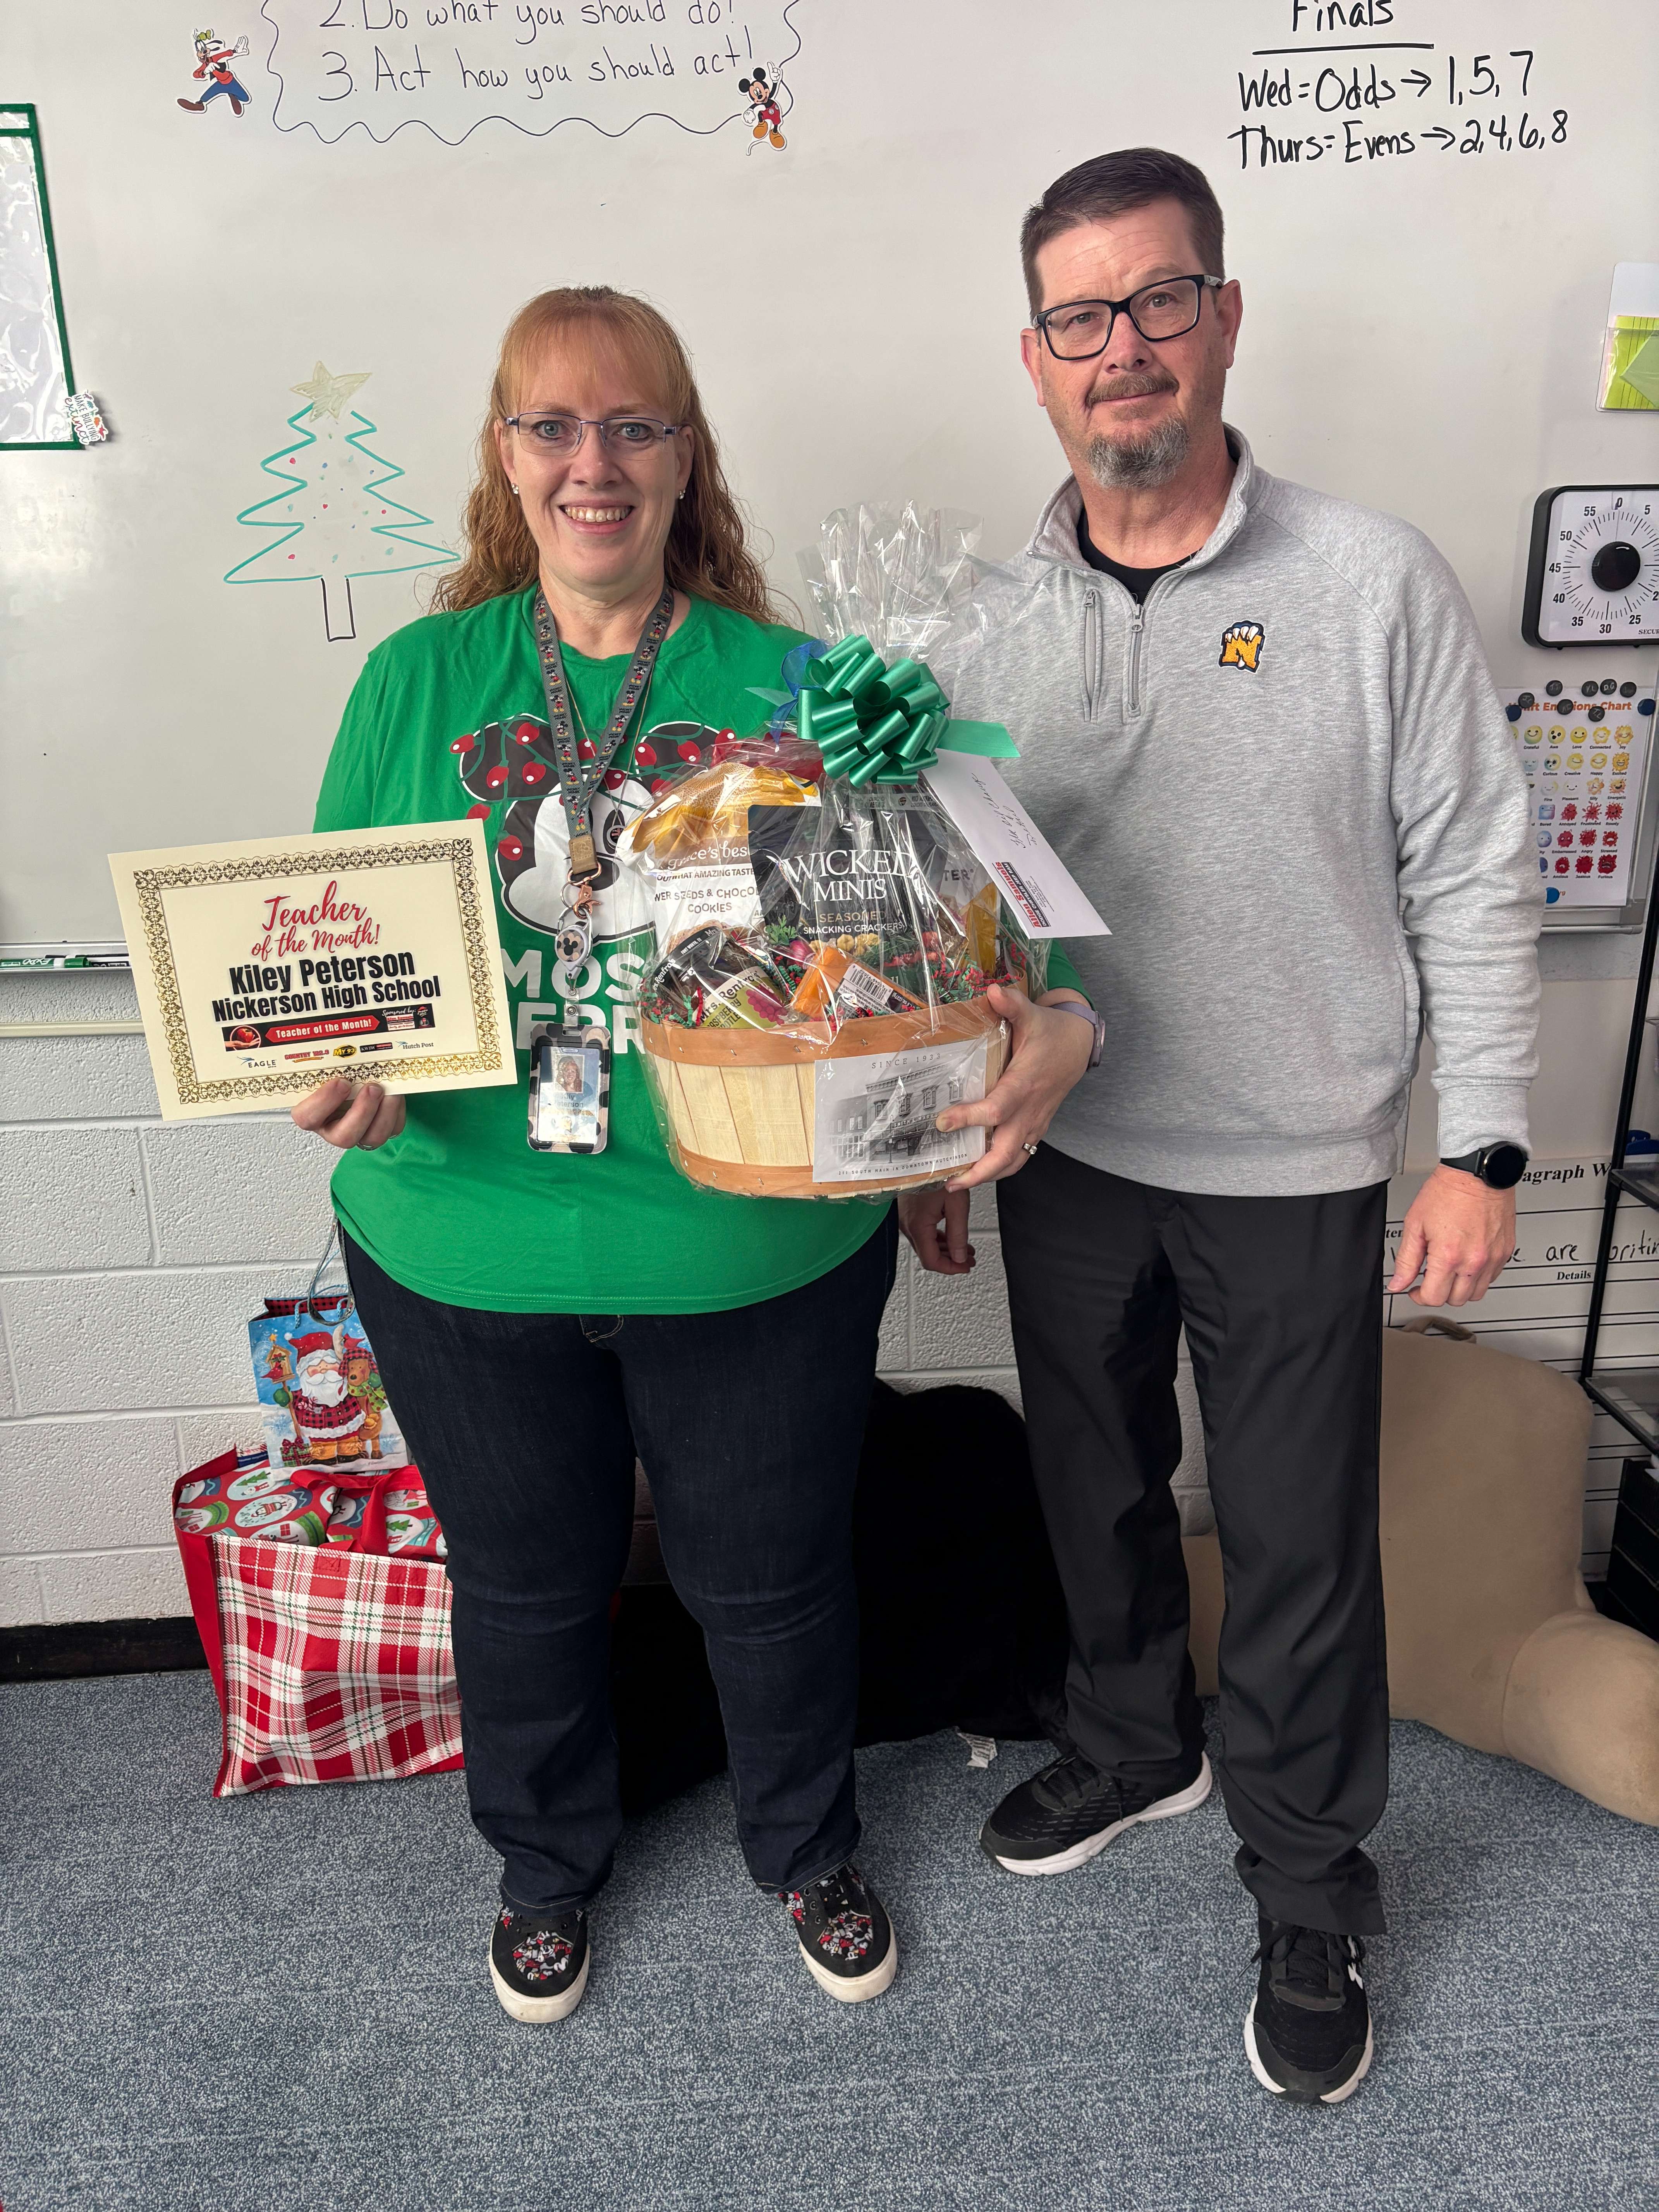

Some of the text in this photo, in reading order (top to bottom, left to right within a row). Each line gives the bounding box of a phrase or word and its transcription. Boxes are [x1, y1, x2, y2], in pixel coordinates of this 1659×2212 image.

[319, 0, 734, 45] 2. Do what you should do!
[1293, 0, 1395, 33] Finals
[318, 25, 754, 101] 3. Act how you should act!
[65, 397, 90, 444] extinct
[74, 394, 100, 440] MAKE BULLYING
[1583, 506, 1596, 517] 55
[1644, 505, 1651, 515] 5
[1560, 530, 1572, 541] 50
[1549, 563, 1561, 573] 45
[1553, 593, 1565, 603] 40
[1652, 591, 1659, 601] 2
[1571, 616, 1583, 627] 35
[1599, 623, 1611, 634] 30
[1629, 615, 1641, 625] 25
[1600, 701, 1632, 711] Chart
[719, 840, 750, 858] bes
[694, 869, 731, 878] AMAZING
[781, 849, 918, 883] WICKED
[995, 861, 1025, 901] Samuels
[674, 890, 704, 900] SEEDS
[706, 888, 713, 897] &
[716, 886, 759, 898] CHOCOL
[814, 878, 887, 903] MINIS
[262, 880, 368, 931] Teacher
[687, 902, 732, 914] COOKIES
[819, 910, 887, 923] SEASONED
[1023, 903, 1042, 928] Allen
[1032, 908, 1048, 927] DODGE
[803, 921, 903, 935] SNACKING CRACKERS
[251, 917, 380, 962] of the Month!
[229, 951, 416, 995] Kiley Peterson
[501, 948, 646, 1002] MOS
[212, 975, 441, 1022] Nickerson High School
[276, 1018, 372, 1038] Teacher of the Month!
[248, 1060, 276, 1068] EAGLE
[872, 1053, 941, 1069] SINCE 1933
[902, 1161, 933, 1170] DOWNTOWN
[936, 1153, 967, 1164] HUTCHINSON
[1522, 1163, 1584, 1185] agraph
[1545, 1243, 1580, 1262] are
[1557, 1271, 1591, 1281] Details
